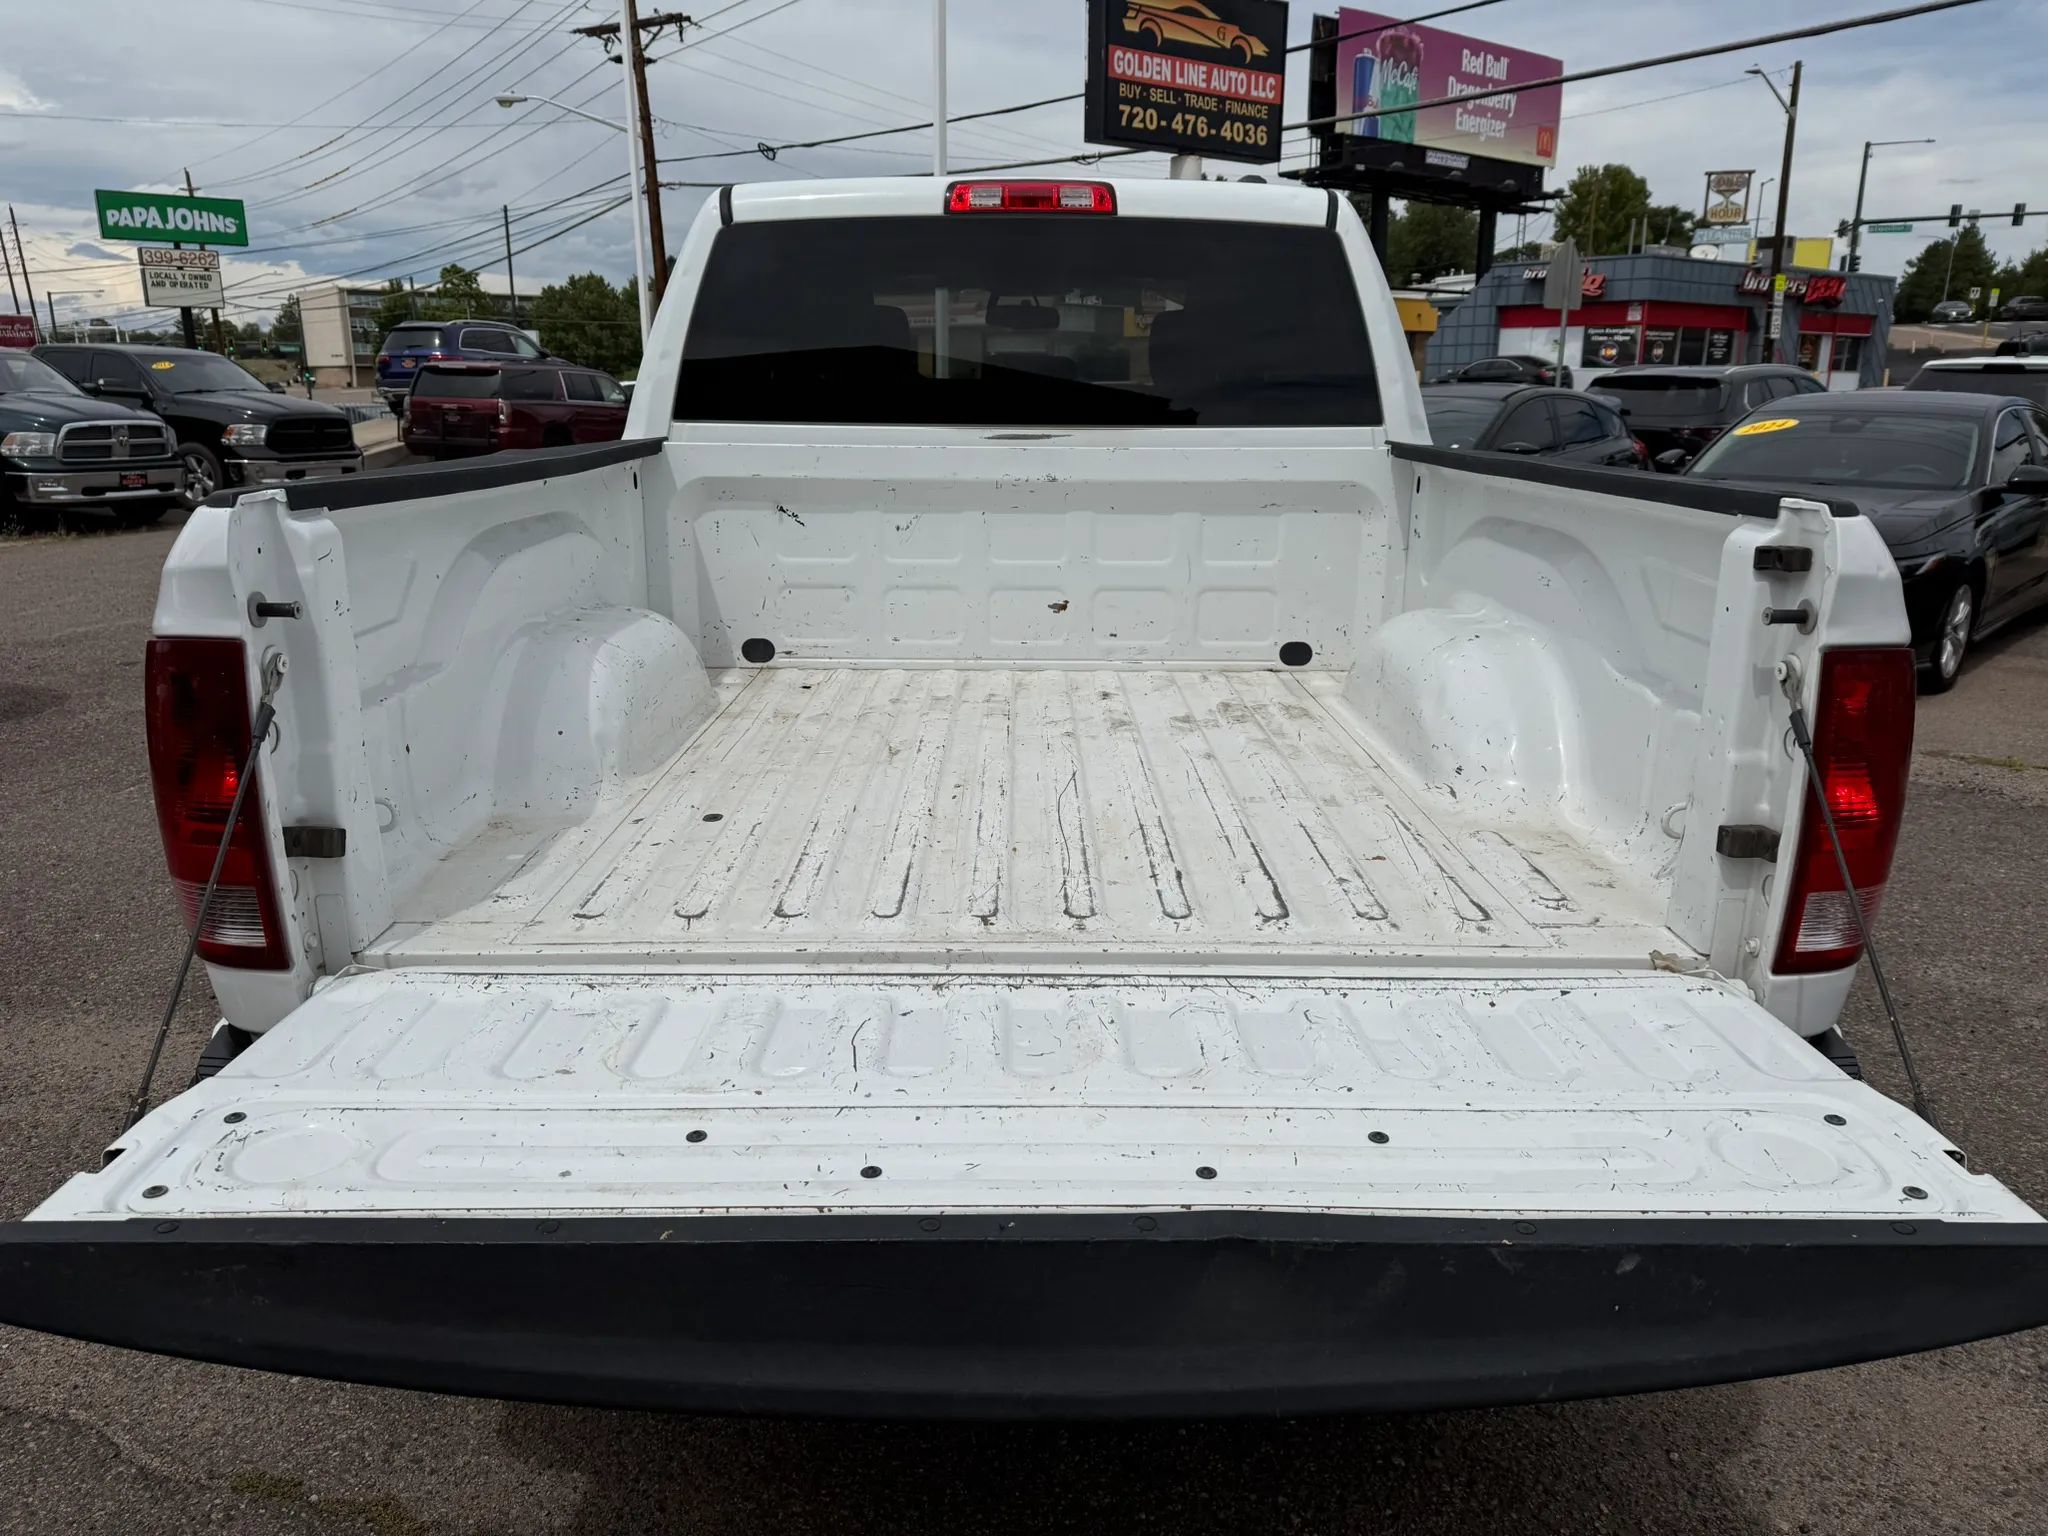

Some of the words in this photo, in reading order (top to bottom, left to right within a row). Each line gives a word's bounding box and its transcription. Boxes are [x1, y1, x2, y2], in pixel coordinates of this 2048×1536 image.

[1114, 50, 1172, 82] GOLDEN
[1176, 61, 1207, 88] LINE
[1210, 67, 1248, 94] AUTO
[1251, 74, 1276, 99] LLC
[1461, 48, 1484, 75] Red
[1485, 53, 1508, 81] Bull
[1119, 83, 1142, 99] BUY
[1150, 88, 1177, 105] SELL
[1184, 93, 1218, 111] TRADE
[1225, 100, 1269, 119] FINANCE
[1455, 109, 1507, 141] Energizer
[106, 206, 164, 230] PAPA
[165, 207, 237, 234] JOHNS
[1711, 208, 1742, 219] HOUR
[144, 250, 217, 267] 399-6262
[169, 281, 209, 289] OPERATED
[188, 273, 212, 282] OWNED
